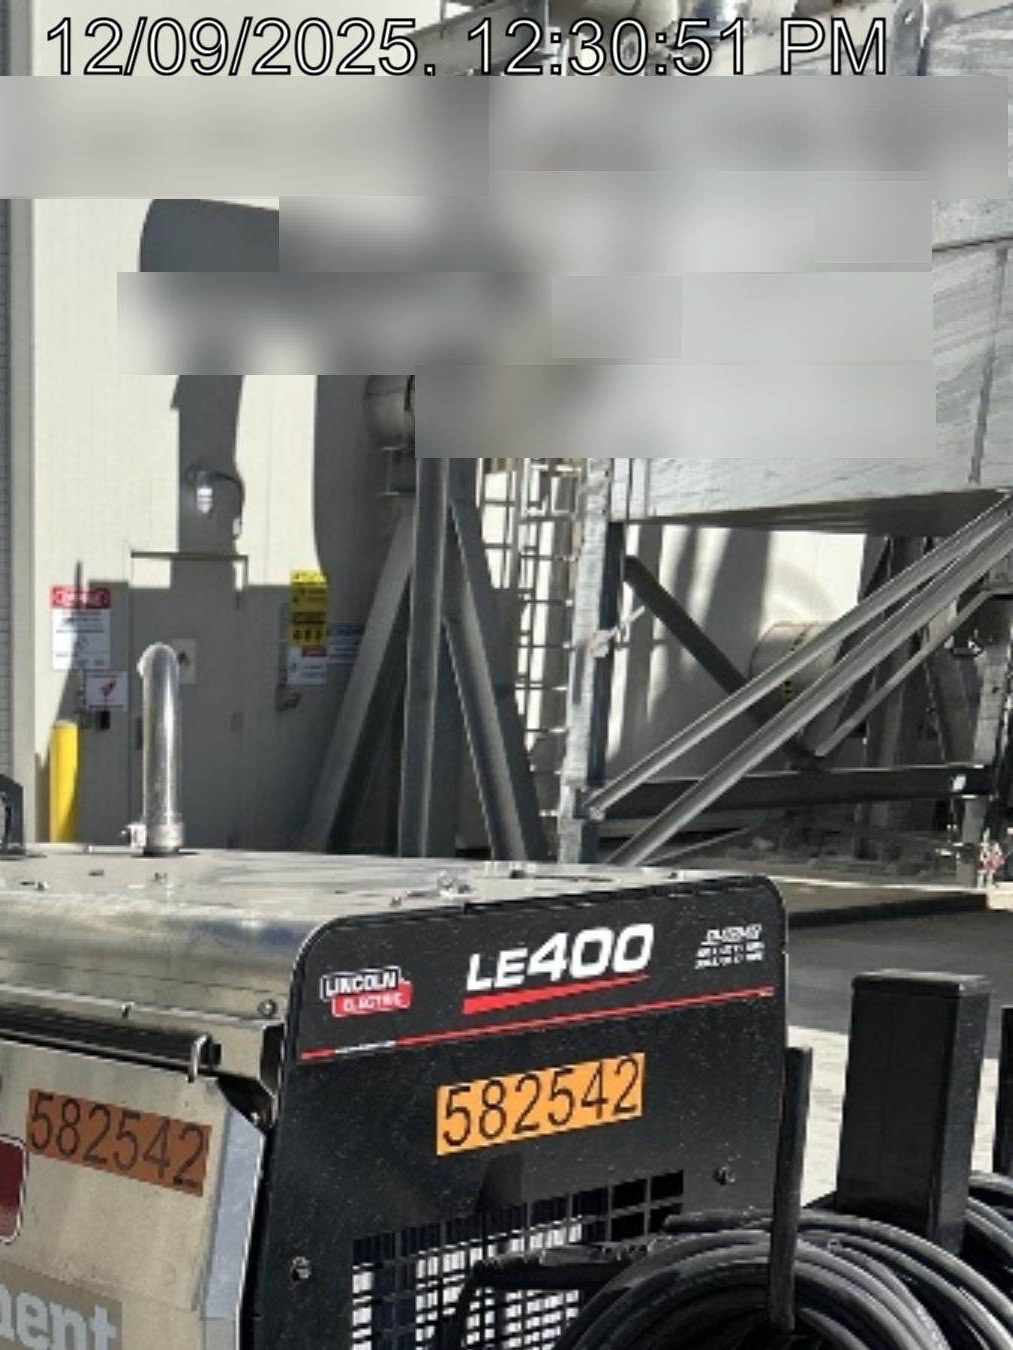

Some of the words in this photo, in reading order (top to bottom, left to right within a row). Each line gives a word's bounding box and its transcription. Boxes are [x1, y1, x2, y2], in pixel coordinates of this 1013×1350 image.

[325, 970, 397, 997] LINCOLN
[465, 923, 655, 991] LE400
[29, 1091, 208, 1190] 582542
[442, 1057, 641, 1147] 582542
